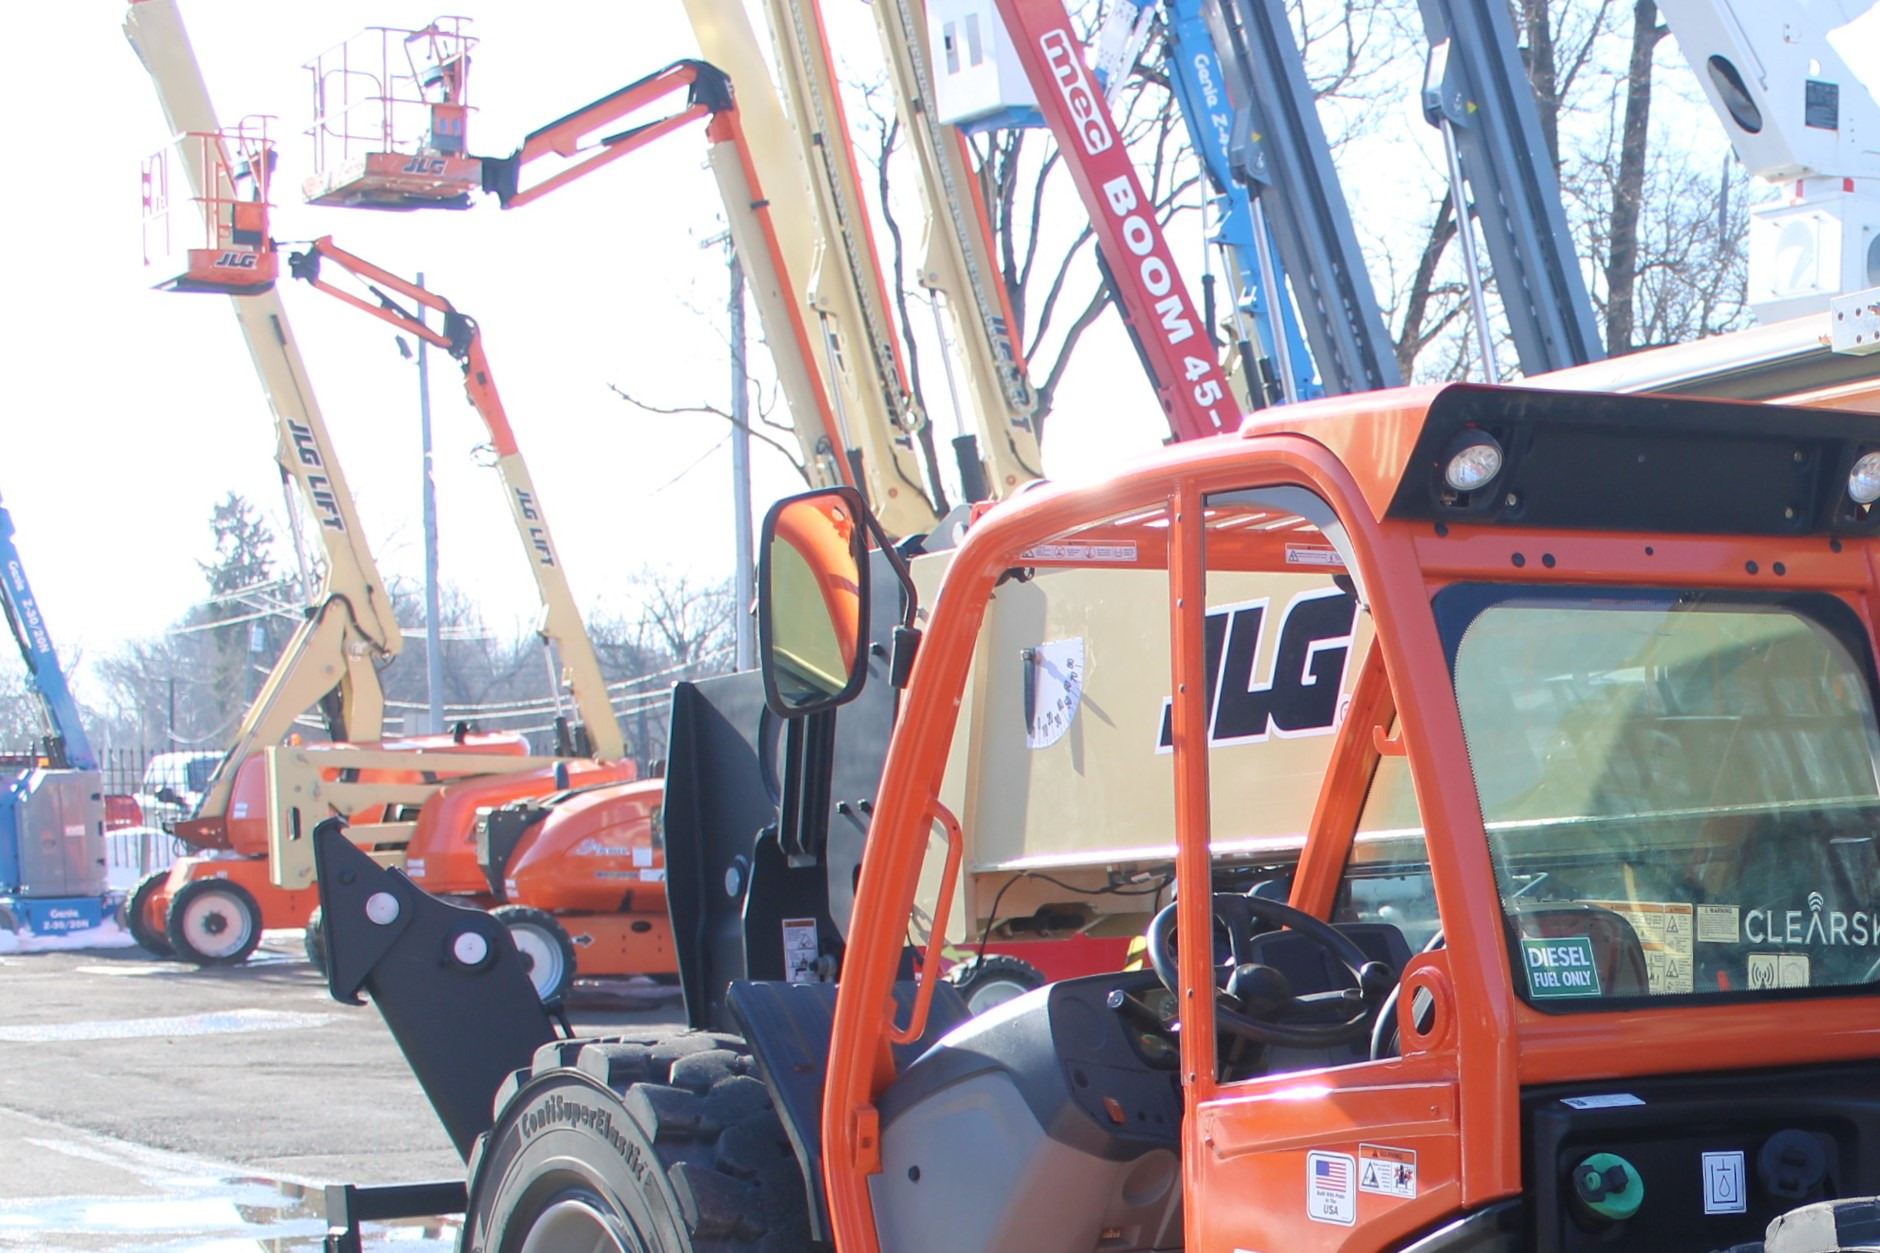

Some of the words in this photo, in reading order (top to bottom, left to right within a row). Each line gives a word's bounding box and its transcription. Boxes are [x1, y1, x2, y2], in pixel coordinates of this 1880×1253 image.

[1041, 29, 1112, 155] mec
[1194, 53, 1218, 109] Genie
[403, 157, 448, 175] JLG
[214, 252, 259, 270] JLG
[1103, 175, 1194, 345] BOOM
[1184, 355, 1223, 435] 45-
[286, 417, 322, 467] JLG
[307, 473, 345, 533] LIFT
[515, 487, 538, 520] JLG
[529, 527, 555, 567] LIFT
[1527, 946, 1590, 968] DIESEL
[1533, 972, 1561, 988] FUEL
[1562, 971, 1591, 986] ONLY
[1323, 1204, 1338, 1216] USA
